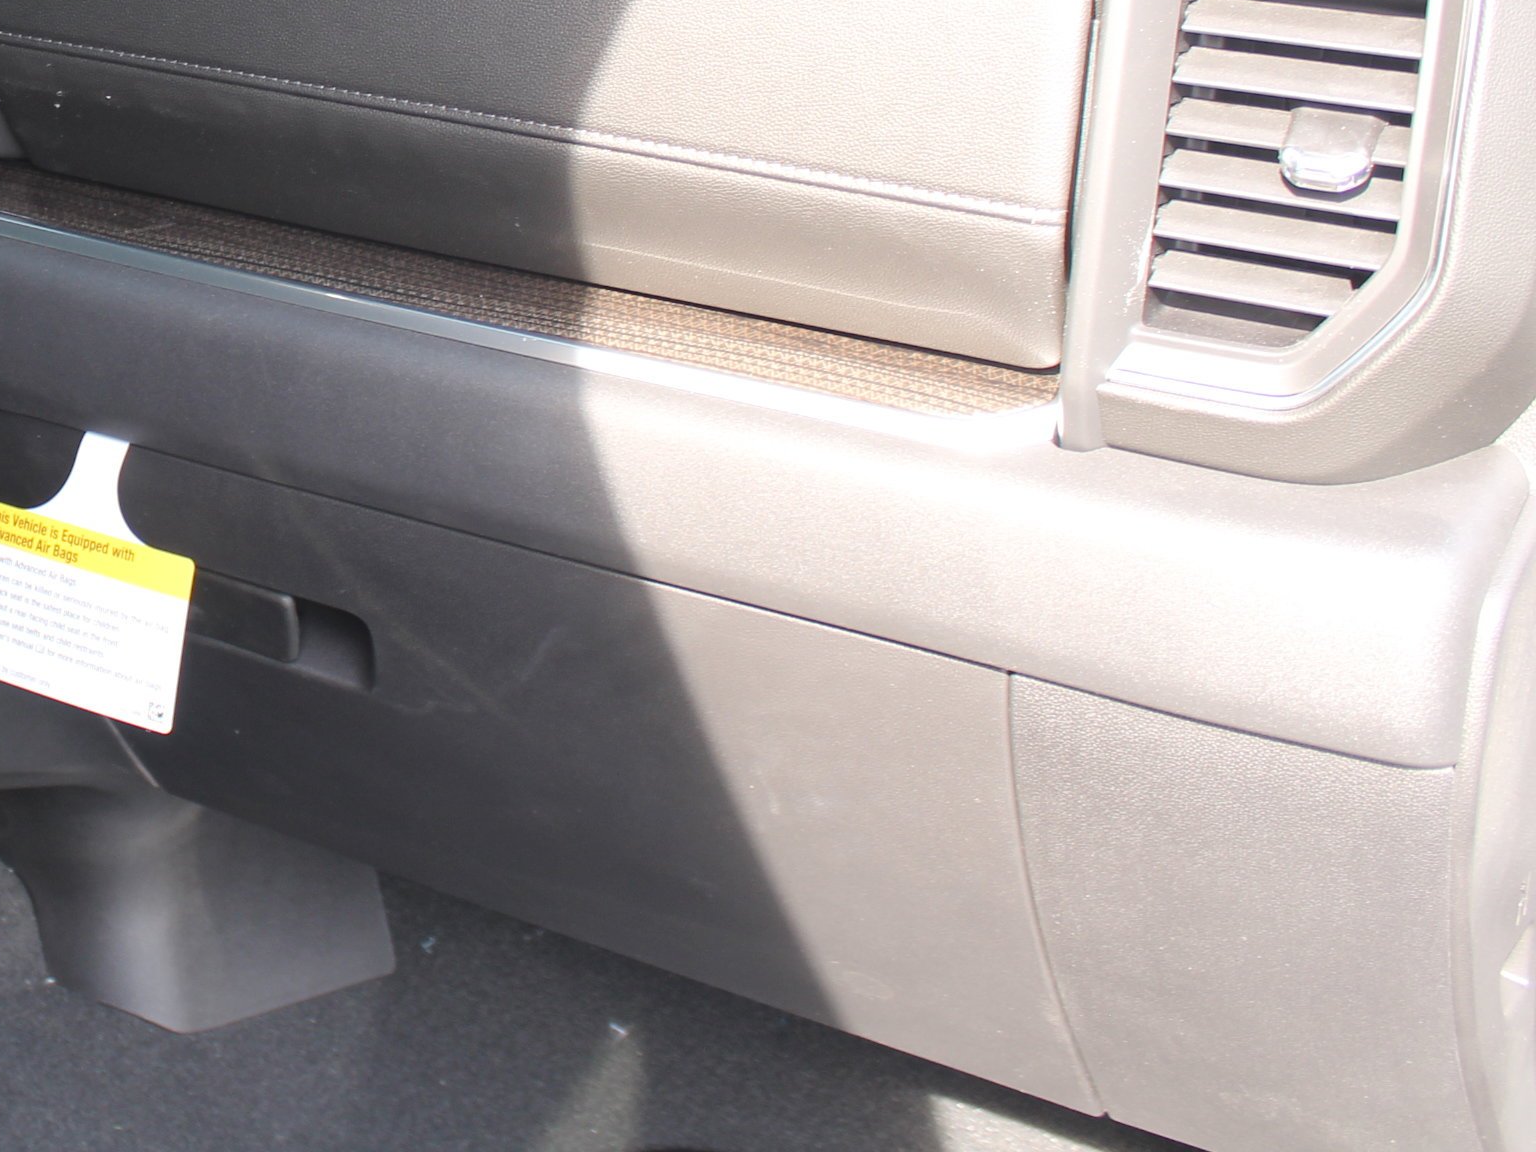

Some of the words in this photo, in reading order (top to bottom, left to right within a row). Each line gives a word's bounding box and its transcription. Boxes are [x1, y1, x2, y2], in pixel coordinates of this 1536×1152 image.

[13, 515, 47, 535] Vehicle
[50, 526, 59, 538] is
[61, 530, 109, 555] Equipped
[111, 546, 135, 561] with
[36, 539, 51, 552] Air
[52, 545, 78, 564] Bags
[0, 555, 12, 566] with
[14, 561, 47, 576] Advanced
